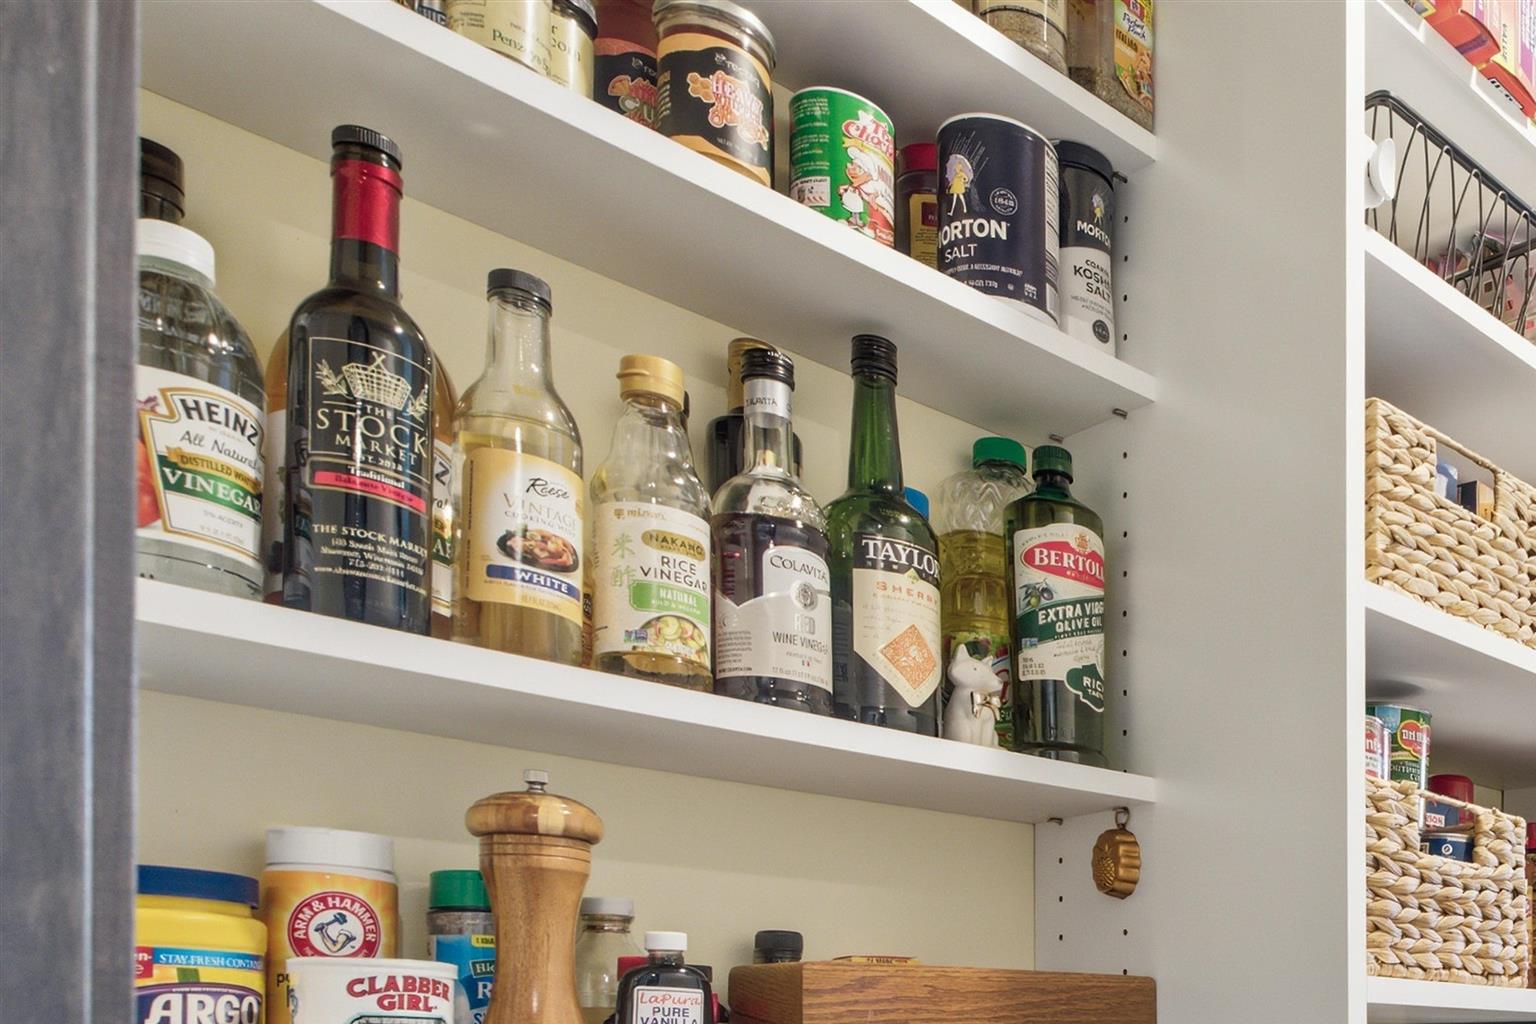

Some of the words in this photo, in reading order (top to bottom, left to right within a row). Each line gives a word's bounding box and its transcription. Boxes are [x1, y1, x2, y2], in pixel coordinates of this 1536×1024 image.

[945, 244, 978, 263] SALT
[1086, 282, 1111, 303] SALT
[365, 403, 392, 418] THE
[179, 398, 259, 447] HEINZ
[317, 408, 427, 458] STOCK
[180, 430, 205, 447] All
[335, 434, 417, 466] MARKET
[180, 454, 232, 477] DISTILLED
[526, 477, 570, 499] Reese
[313, 524, 338, 534] THE
[342, 527, 387, 543] STOCK
[649, 533, 703, 556] NAKANO
[661, 556, 697, 576] RICE
[770, 554, 829, 584] COLAVITA
[514, 569, 569, 594] WHITE
[659, 589, 697, 608] NATURAL
[1038, 604, 1083, 625] EXTRA
[1055, 619, 1090, 634] OLIVE
[1092, 618, 1103, 628] OIL
[772, 631, 798, 646] WINE
[294, 906, 315, 939] ARM
[312, 899, 326, 911] &
[327, 896, 377, 942] HAMMER
[346, 975, 450, 1002] CLABBER
[376, 994, 434, 1012] GIRL
[652, 1006, 690, 1018] PURE
